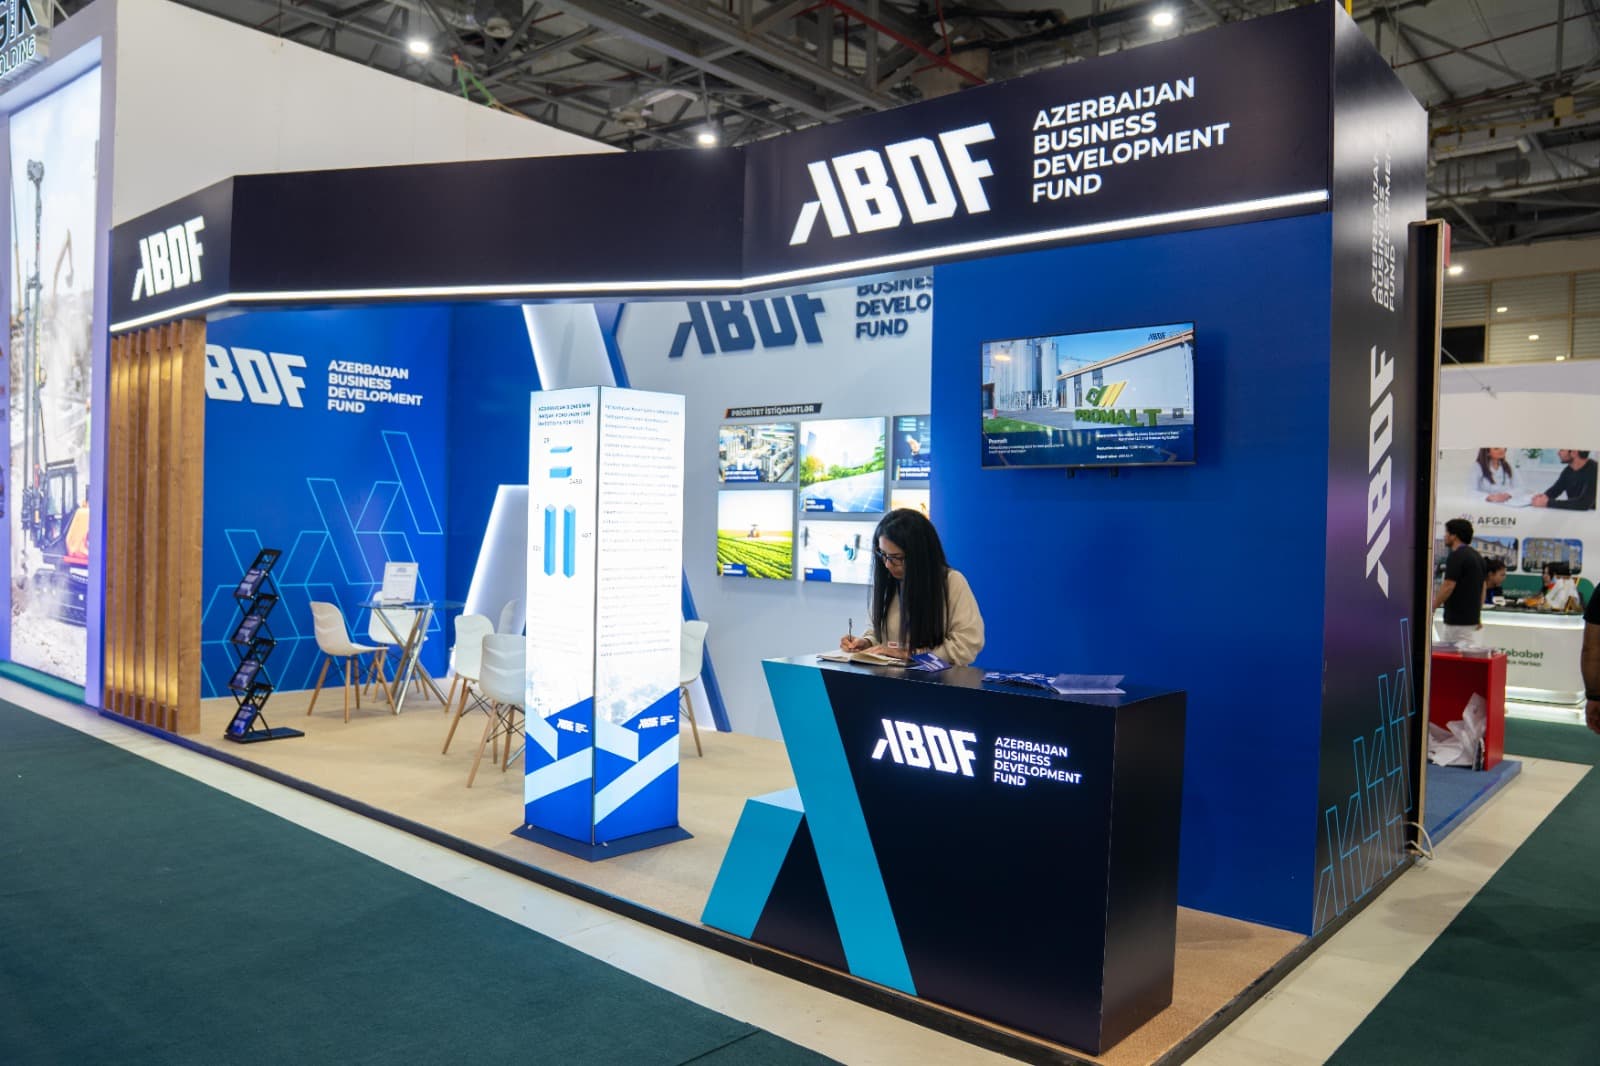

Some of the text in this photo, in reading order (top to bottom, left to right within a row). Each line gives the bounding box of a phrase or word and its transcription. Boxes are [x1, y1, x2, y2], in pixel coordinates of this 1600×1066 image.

[0, 34, 37, 78] OLDING
[1032, 77, 1196, 132] AZERBAIJAN
[1033, 112, 1158, 155] BUSINESS
[1032, 123, 1231, 179] DEVELOPMENT
[789, 122, 995, 246] ABDF
[1032, 172, 1102, 203] FUND
[1383, 146, 1392, 309] DEVELOPME
[131, 215, 205, 302] ABDF
[1377, 186, 1385, 305] BUSINESS
[856, 276, 933, 297] BUSINE
[1388, 245, 1396, 312] FUND
[855, 292, 932, 318] DEVELO
[855, 317, 909, 340] FUND
[205, 343, 307, 409] BDF
[328, 359, 409, 380] AZERBAIJAN
[328, 373, 392, 391] BUSINESS
[327, 386, 423, 406] DEVELOPMENT
[327, 399, 365, 414] FUND
[1365, 345, 1394, 599] ABDF
[1477, 516, 1517, 526] AFGEN
[871, 718, 977, 777] ABDF
[994, 736, 1069, 758] AZERBAIJAN
[994, 749, 1051, 767] BUSINESS
[993, 760, 1082, 784] DEVELOPMENT
[993, 772, 1027, 787] FUND
